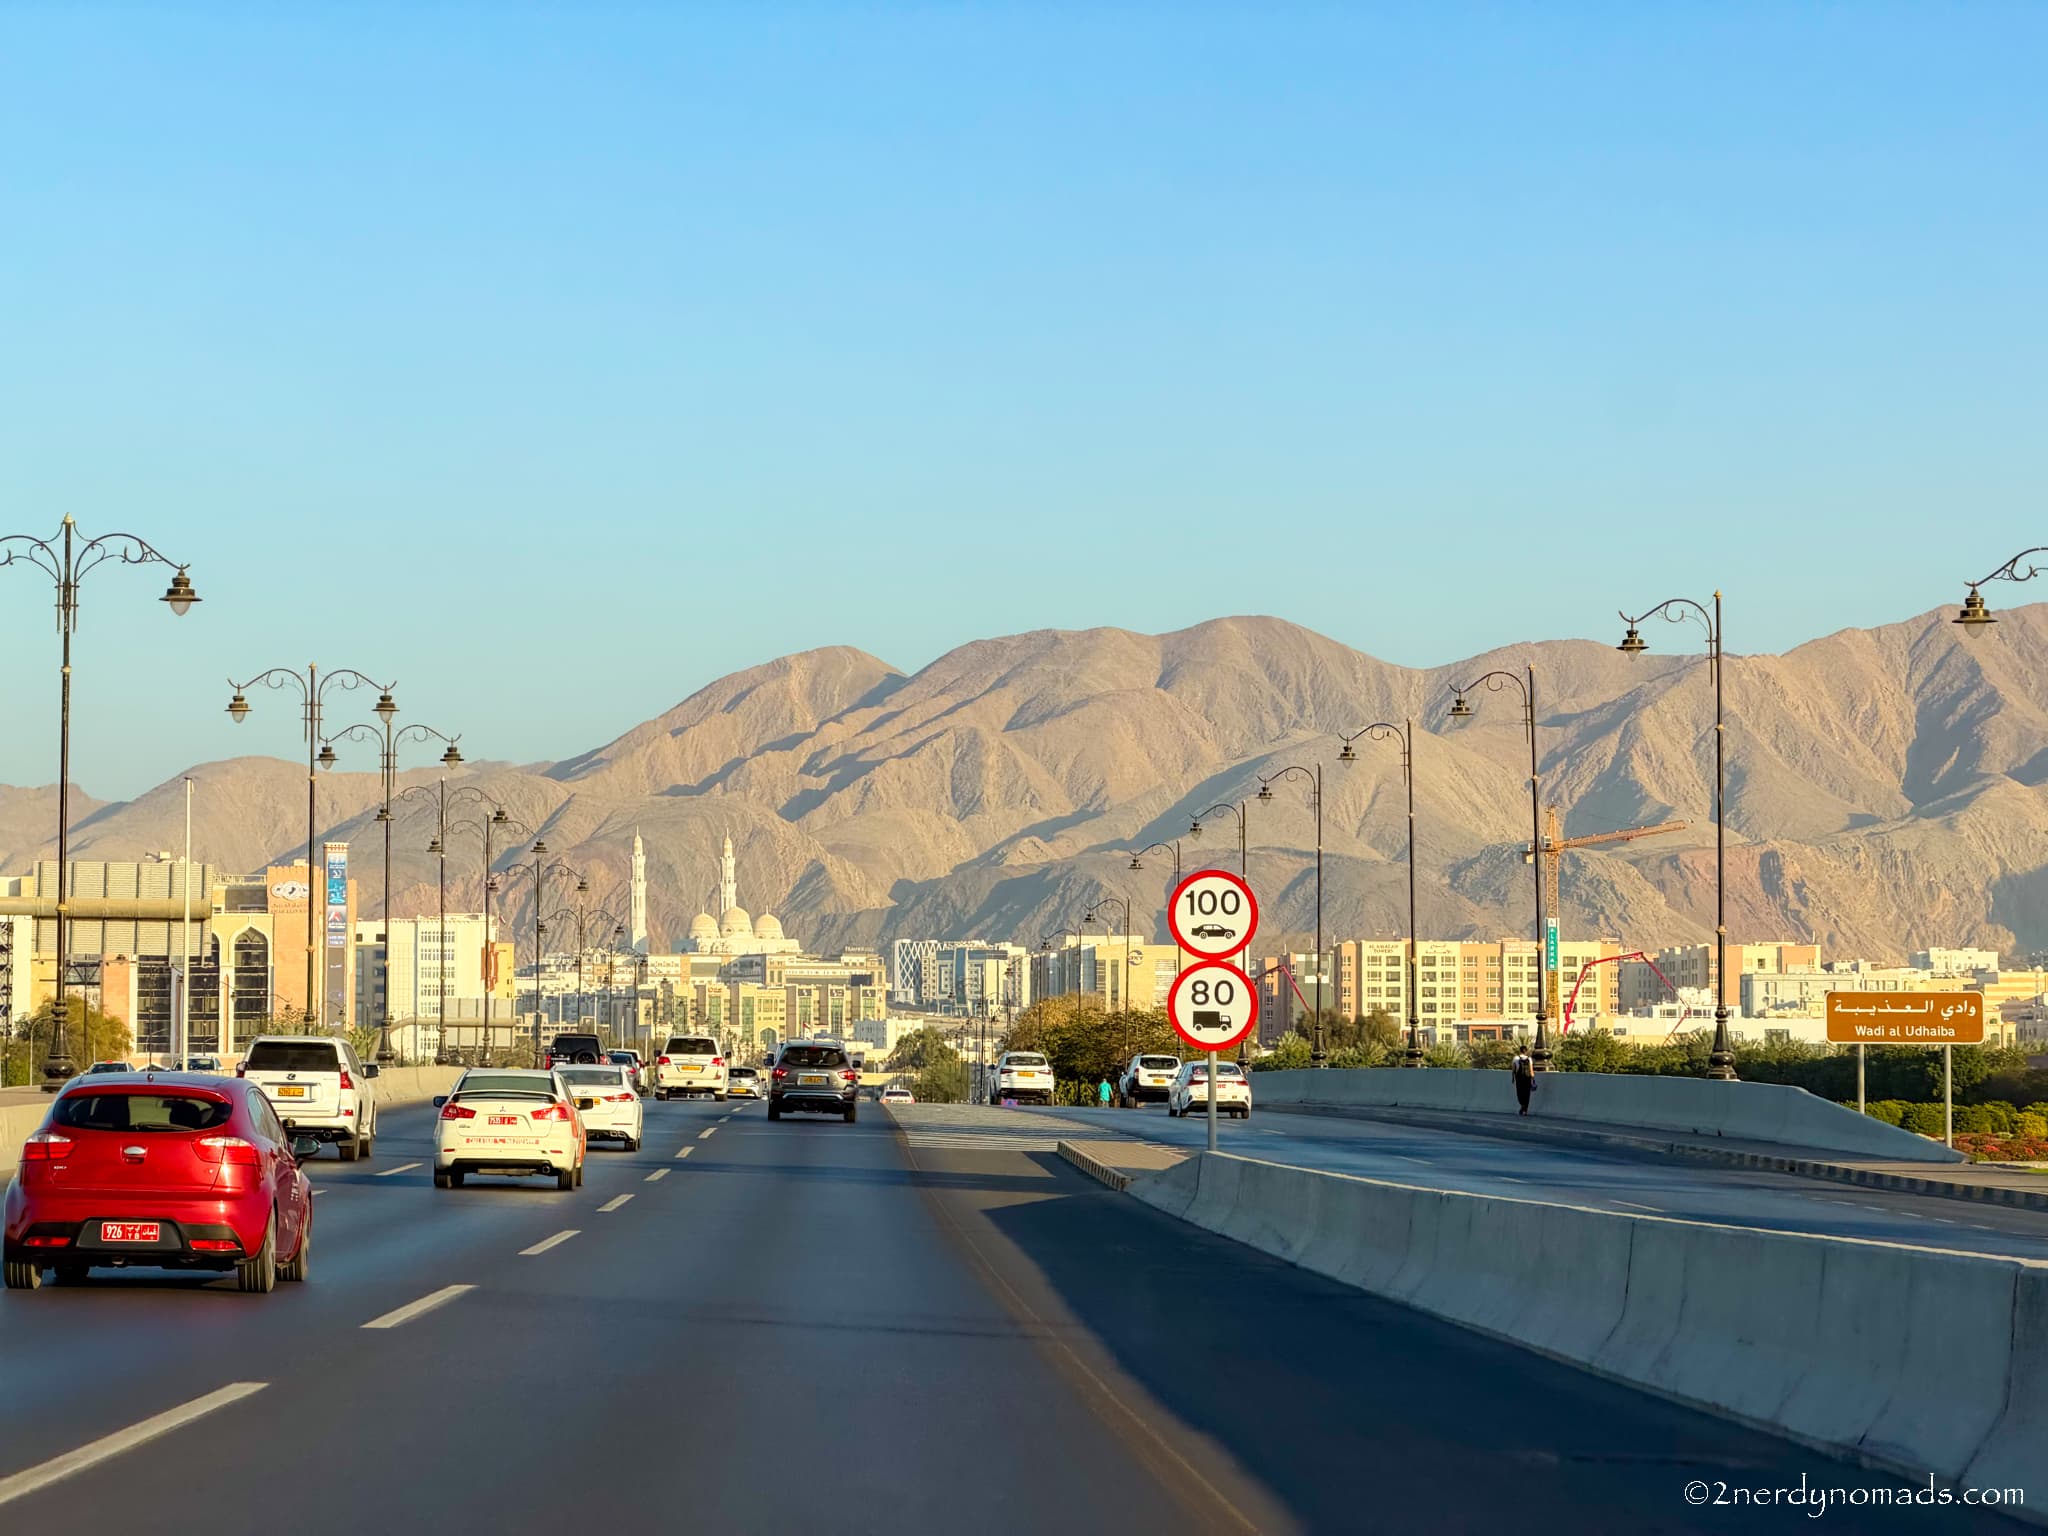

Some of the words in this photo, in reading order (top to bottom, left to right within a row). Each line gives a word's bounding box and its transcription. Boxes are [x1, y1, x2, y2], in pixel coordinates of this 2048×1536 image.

[1185, 889, 1241, 916] 100
[1191, 980, 1234, 1006] 80
[1940, 1000, 1976, 1021] وادي
[1855, 1025, 1885, 1036] Wadi
[1889, 1026, 1901, 1037] al
[1905, 1025, 1956, 1037] Udhaiba
[106, 1225, 122, 1239] 926
